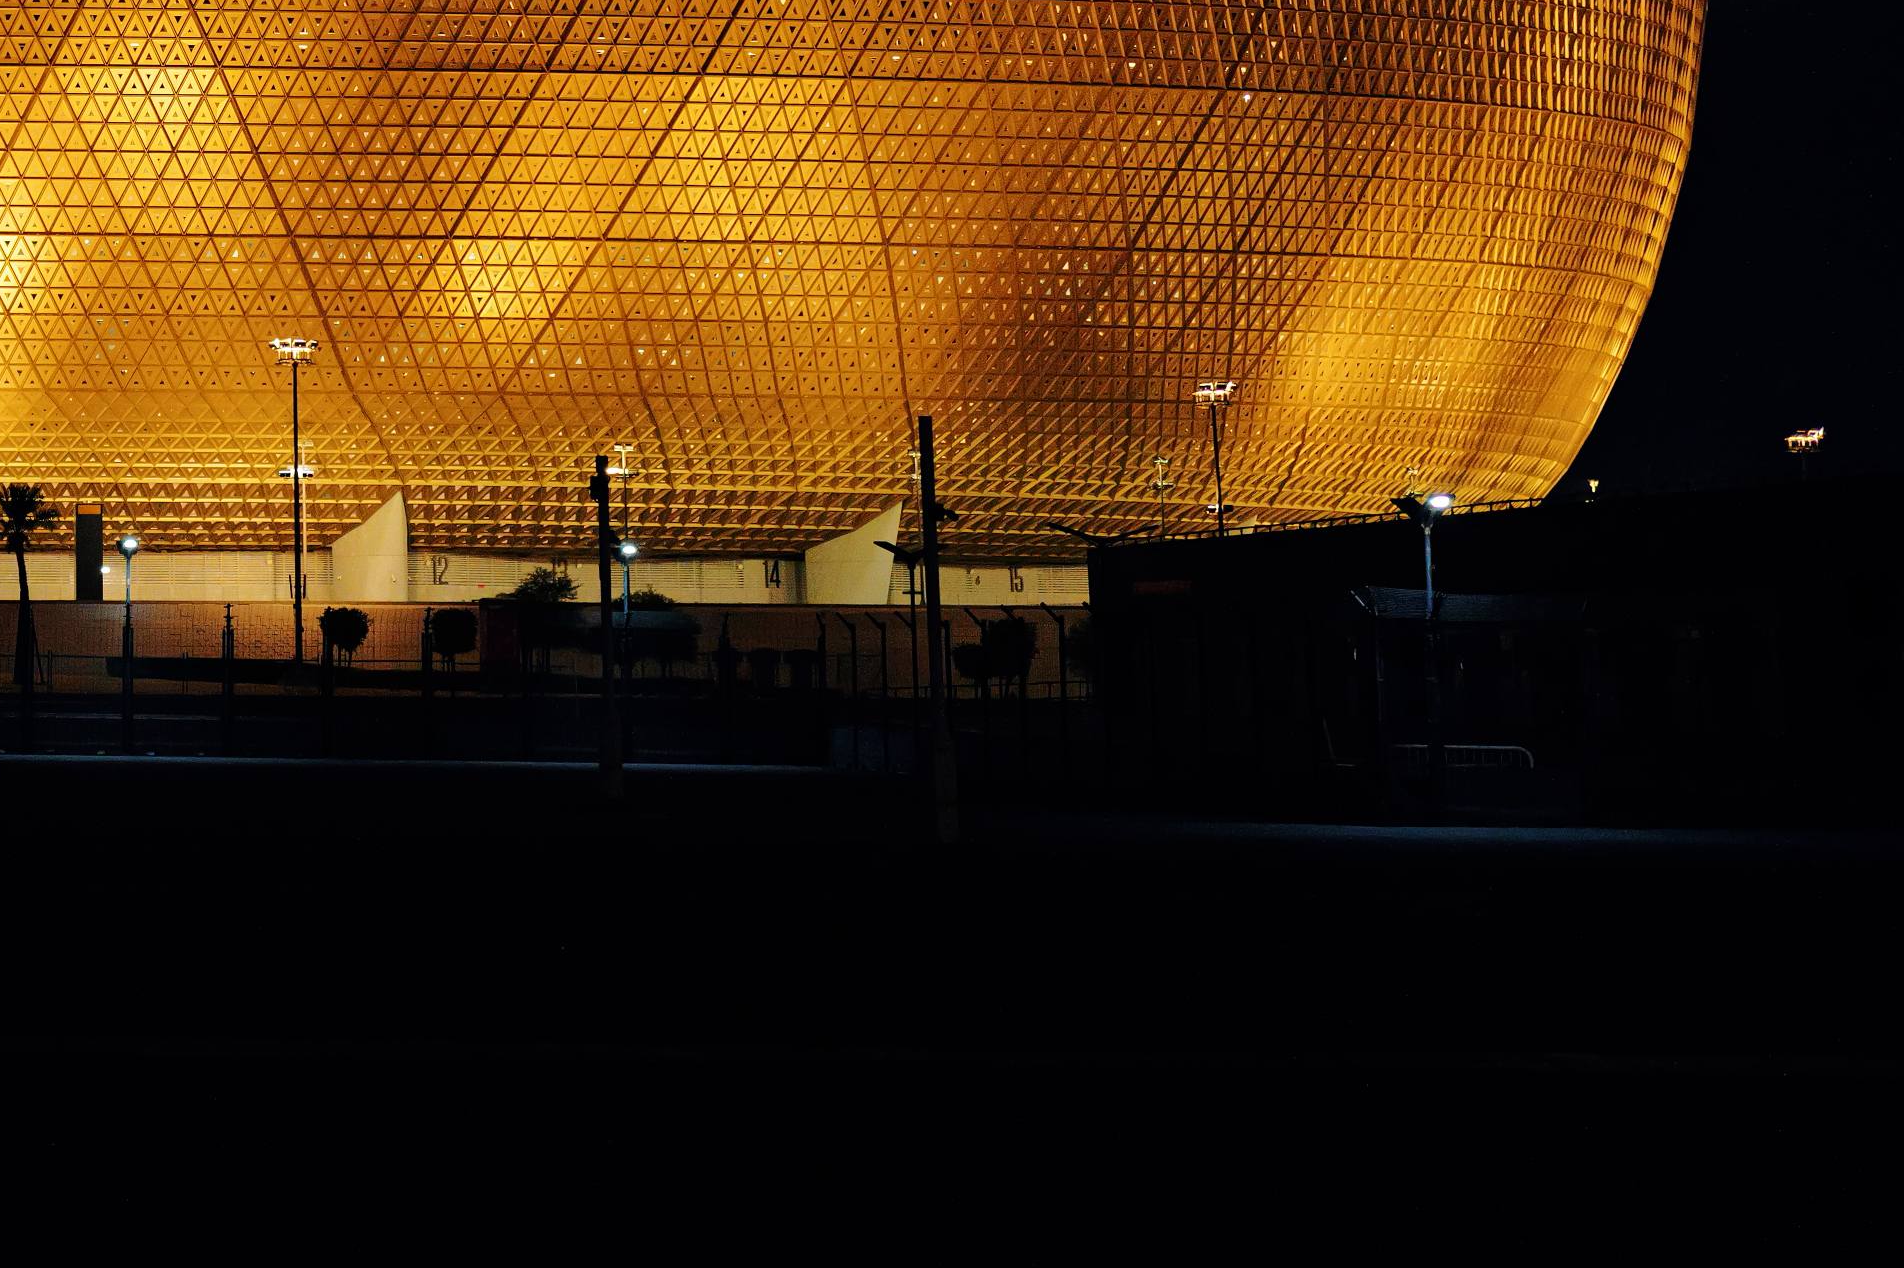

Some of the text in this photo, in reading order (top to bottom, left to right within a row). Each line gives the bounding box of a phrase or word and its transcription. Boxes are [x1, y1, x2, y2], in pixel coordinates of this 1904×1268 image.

[431, 554, 449, 585] 12
[763, 559, 781, 588] 14
[1008, 564, 1024, 592] 15
